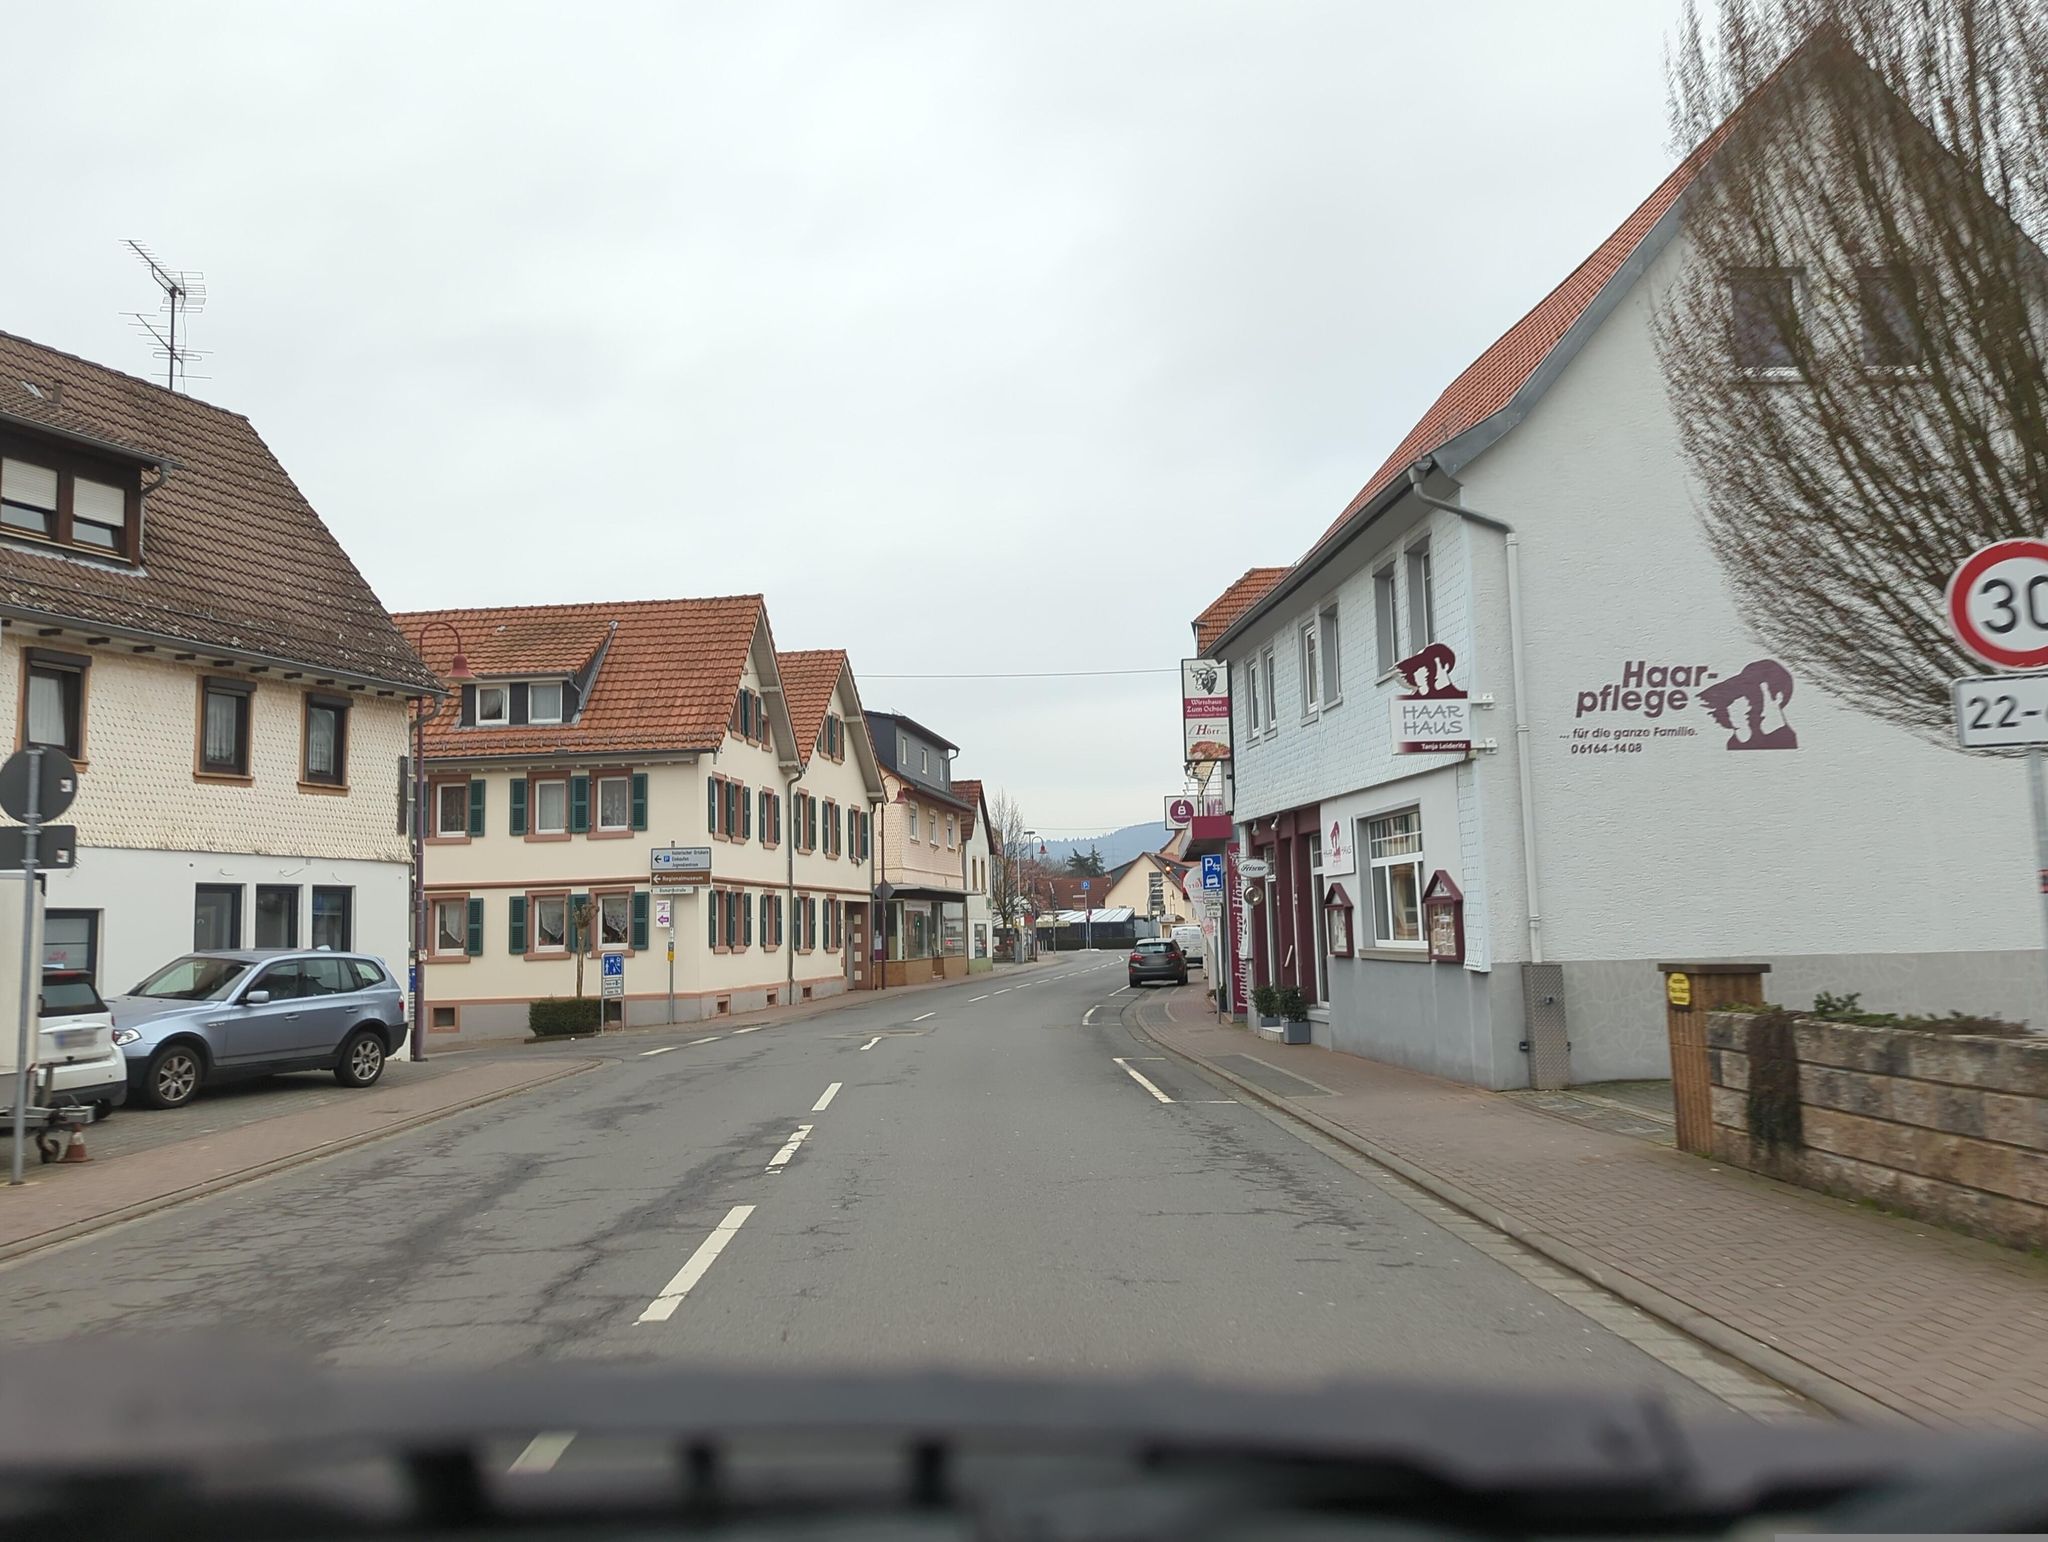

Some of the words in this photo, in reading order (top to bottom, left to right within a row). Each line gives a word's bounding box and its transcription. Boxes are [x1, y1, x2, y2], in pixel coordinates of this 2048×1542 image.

[1979, 575, 2048, 635] 30
[1622, 660, 1719, 689] Haar-
[1186, 705, 1203, 713] Zum
[1203, 705, 1228, 713] Ochsen
[1575, 684, 1689, 719] pflege
[1403, 704, 1464, 720] HAAR
[1966, 695, 2048, 730] 22-
[1404, 720, 1463, 735] HAUS
[1572, 728, 1589, 739] für
[1592, 727, 1611, 738] die
[1613, 729, 1650, 740] ganze
[1204, 857, 1213, 872] P
